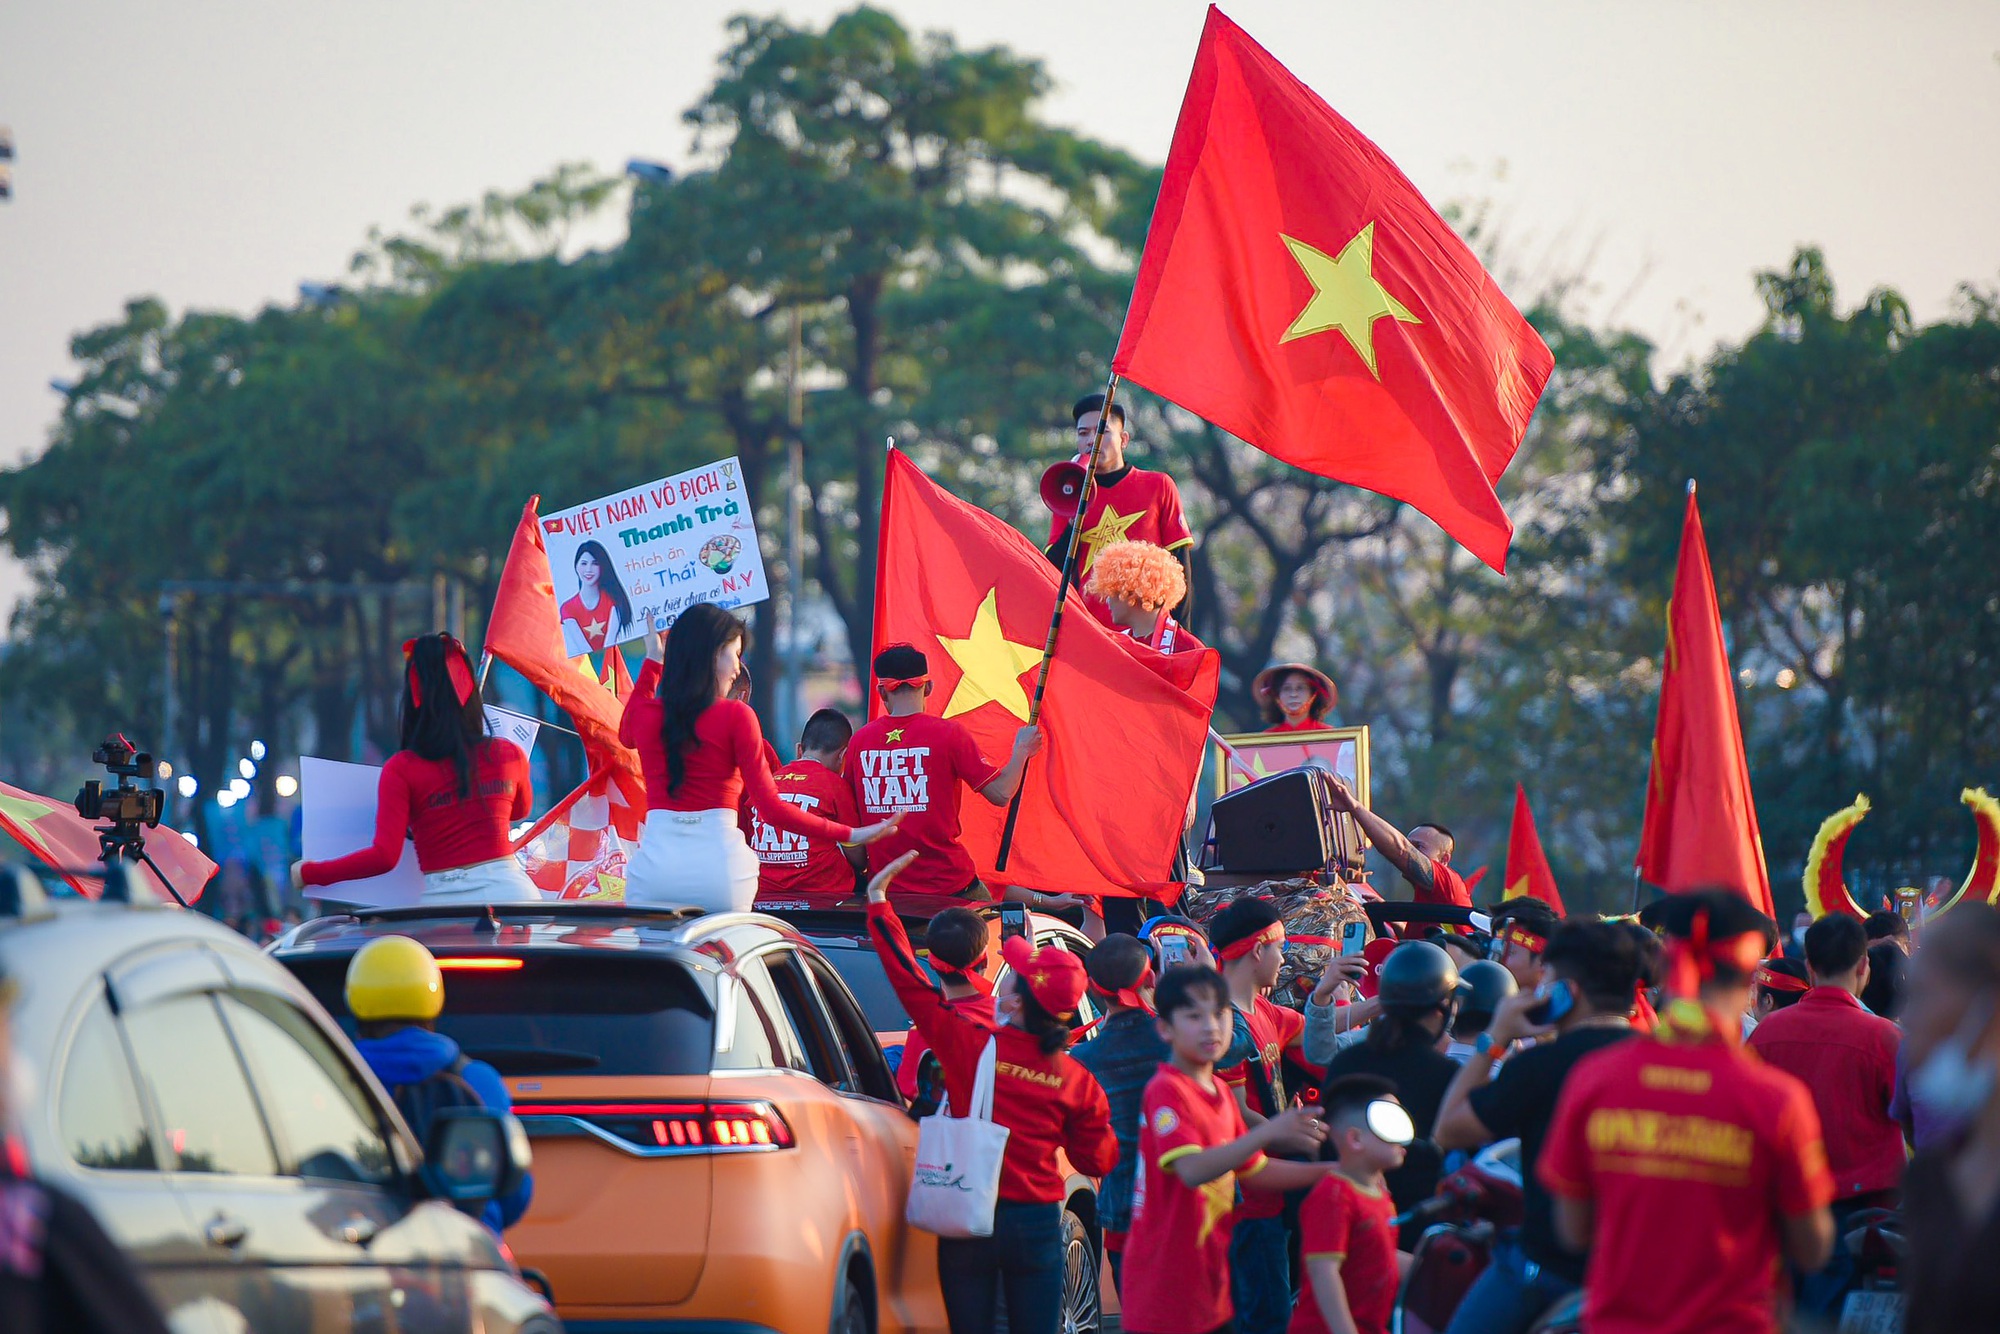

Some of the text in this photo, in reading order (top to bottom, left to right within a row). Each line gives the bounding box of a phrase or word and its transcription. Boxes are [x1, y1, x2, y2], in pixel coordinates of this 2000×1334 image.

[565, 471, 720, 537] VIỆT NAM VÔ ĐỊCH
[619, 498, 739, 548] Thanh Trà
[625, 547, 686, 573] thích ăn
[654, 560, 697, 588] Thái
[721, 570, 754, 595] N.Y
[860, 747, 930, 777] VIET
[862, 775, 929, 805] NAM
